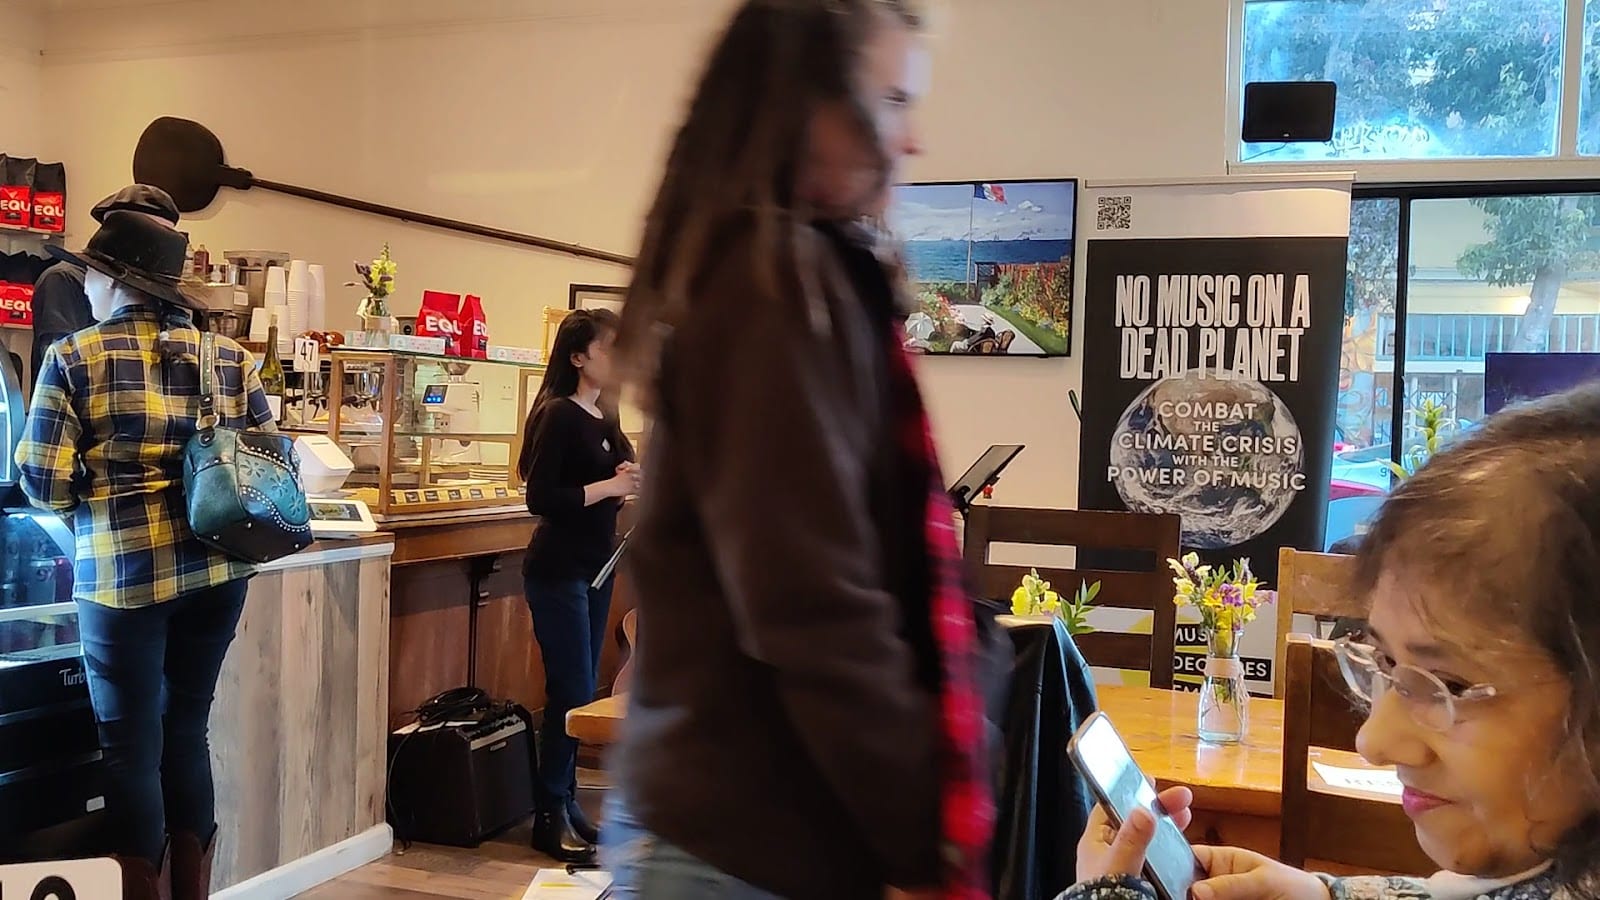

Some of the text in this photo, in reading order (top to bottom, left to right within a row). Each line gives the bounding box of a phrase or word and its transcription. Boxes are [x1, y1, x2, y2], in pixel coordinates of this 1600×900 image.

[1115, 274, 1311, 328] NO MUSIC ON A
[300, 341, 314, 361] 47
[1120, 327, 1304, 381] DEAD PLANET
[1158, 401, 1257, 420] COMBAT
[1193, 421, 1220, 432] THE
[1118, 432, 1297, 455] CLIMATE CRISIS
[1172, 454, 1239, 468] WITH THE
[1107, 465, 1306, 491] POWER OF MUSIC
[1175, 627, 1208, 642] MUS
[58, 667, 86, 686] Turb
